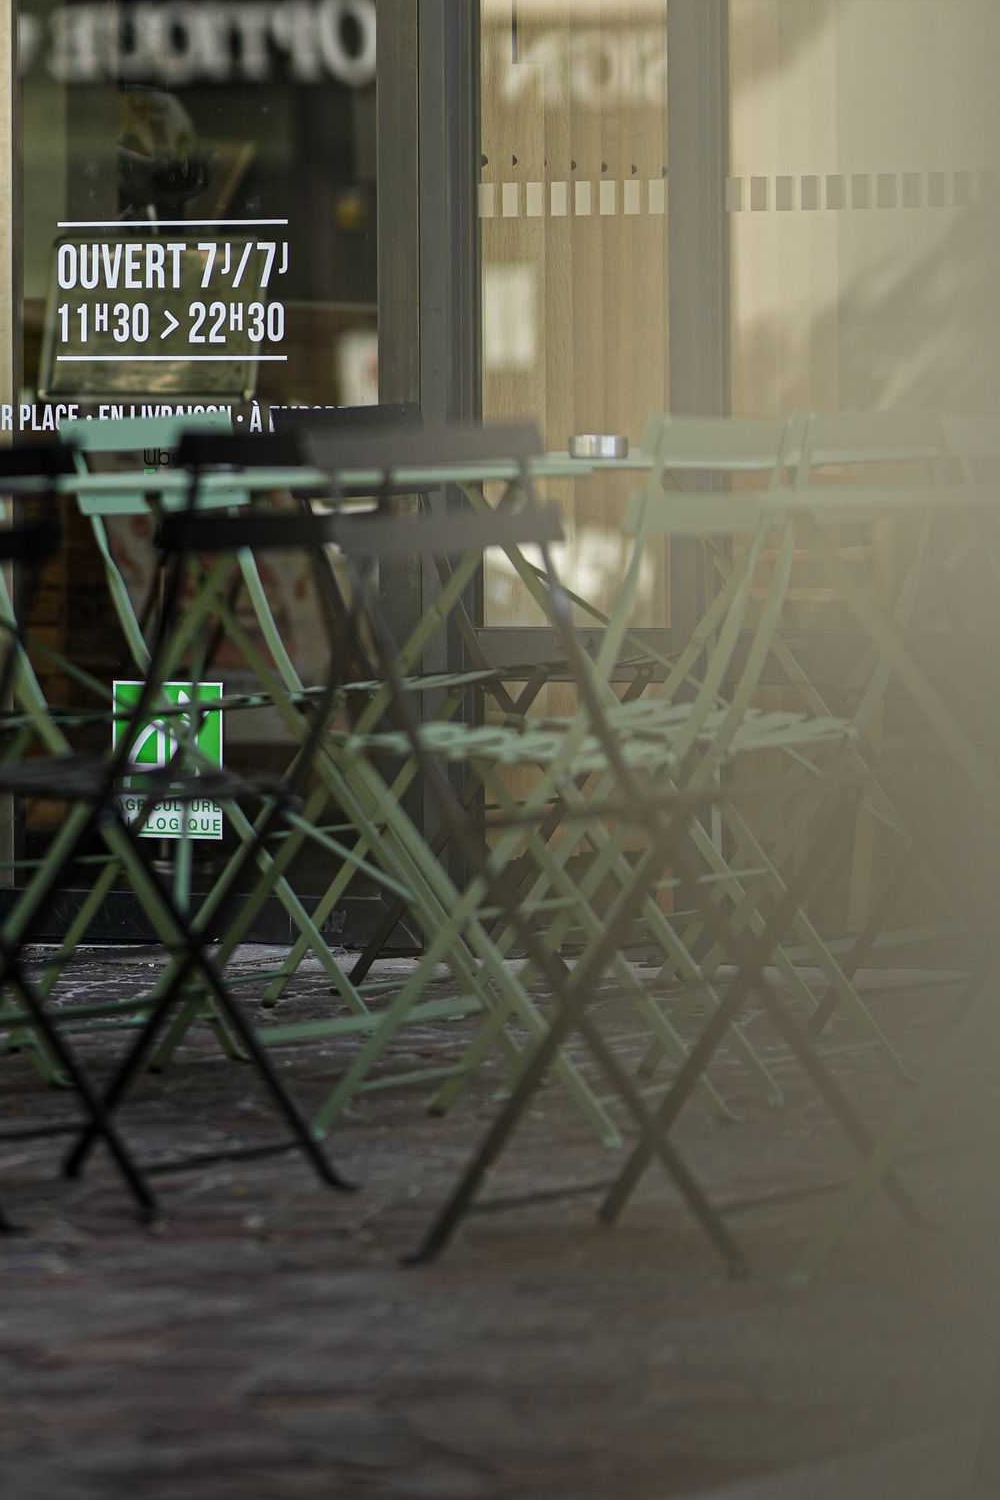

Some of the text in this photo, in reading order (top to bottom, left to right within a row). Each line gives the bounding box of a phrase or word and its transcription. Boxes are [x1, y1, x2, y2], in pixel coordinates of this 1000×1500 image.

[58, 243, 187, 289] OUVERT
[58, 302, 149, 342] 11H30
[188, 301, 285, 343] 22H30
[19, 403, 79, 431] PLACE
[249, 400, 263, 432] À
[117, 798, 221, 813] GRCULURE
